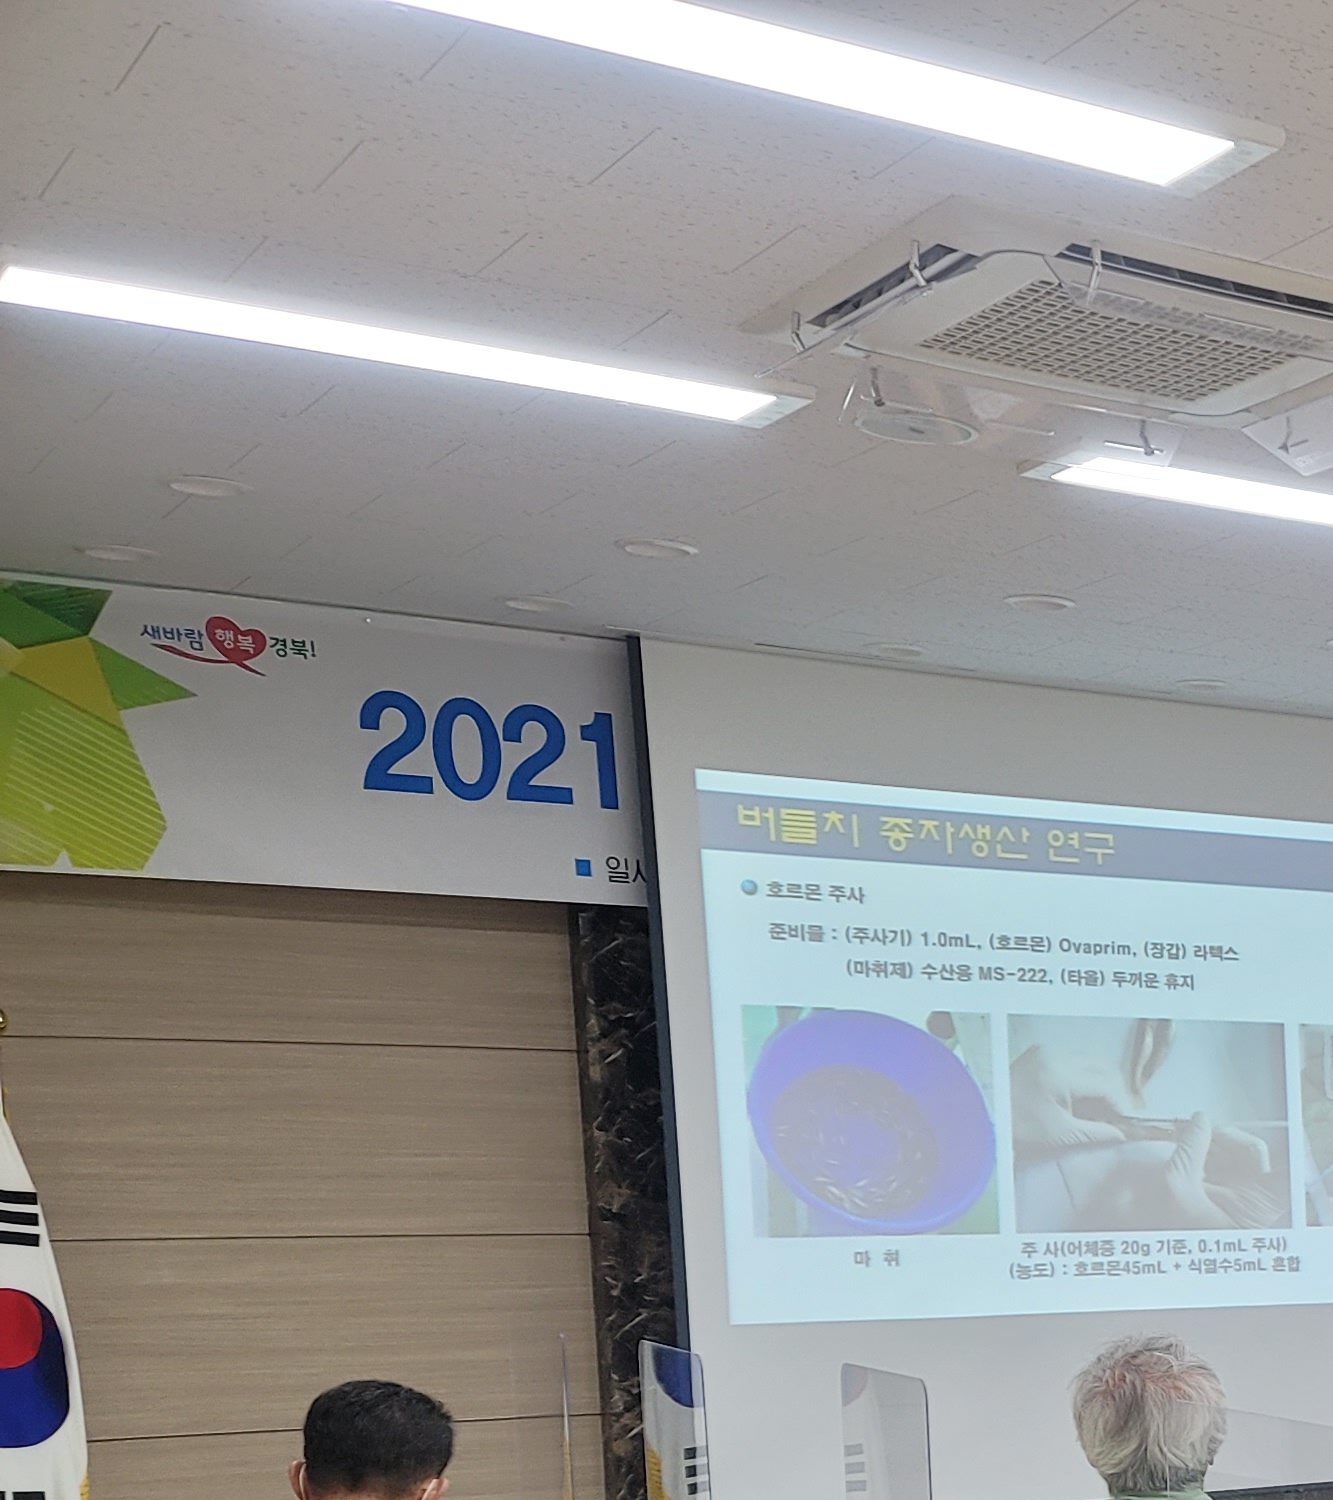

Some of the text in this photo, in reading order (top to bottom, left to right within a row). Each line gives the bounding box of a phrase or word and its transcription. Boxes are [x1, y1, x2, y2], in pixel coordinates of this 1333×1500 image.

[140, 622, 317, 661] 새바람 행복 경북!
[359, 690, 619, 811] 2021
[737, 804, 1116, 865] 버들치 종자생산 연구
[766, 880, 865, 904] 호르몬 주사
[768, 922, 826, 943] 준비물
[845, 926, 913, 948] (주사기)
[919, 931, 982, 951] 1.0mL,
[989, 934, 1052, 954] (호르몬)
[1058, 938, 1138, 959] Ovaprim,
[1143, 940, 1187, 960] (장갑)
[1193, 943, 1240, 963] 라텍스
[846, 959, 914, 980] (마취제)
[978, 966, 1054, 986] MS-222,
[1060, 968, 1105, 988] (타올)
[1111, 970, 1159, 990] 두꺼운
[1164, 972, 1195, 992] 휴지
[854, 1248, 901, 1269] 마 취
[1020, 1242, 1038, 1260] 주
[1120, 1240, 1151, 1259] 20g
[1156, 1238, 1193, 1257] 기준,
[1198, 1238, 1247, 1255] 0.1mL
[1251, 1236, 1288, 1254] 주사)
[1271, 1254, 1301, 1274] 혼합
